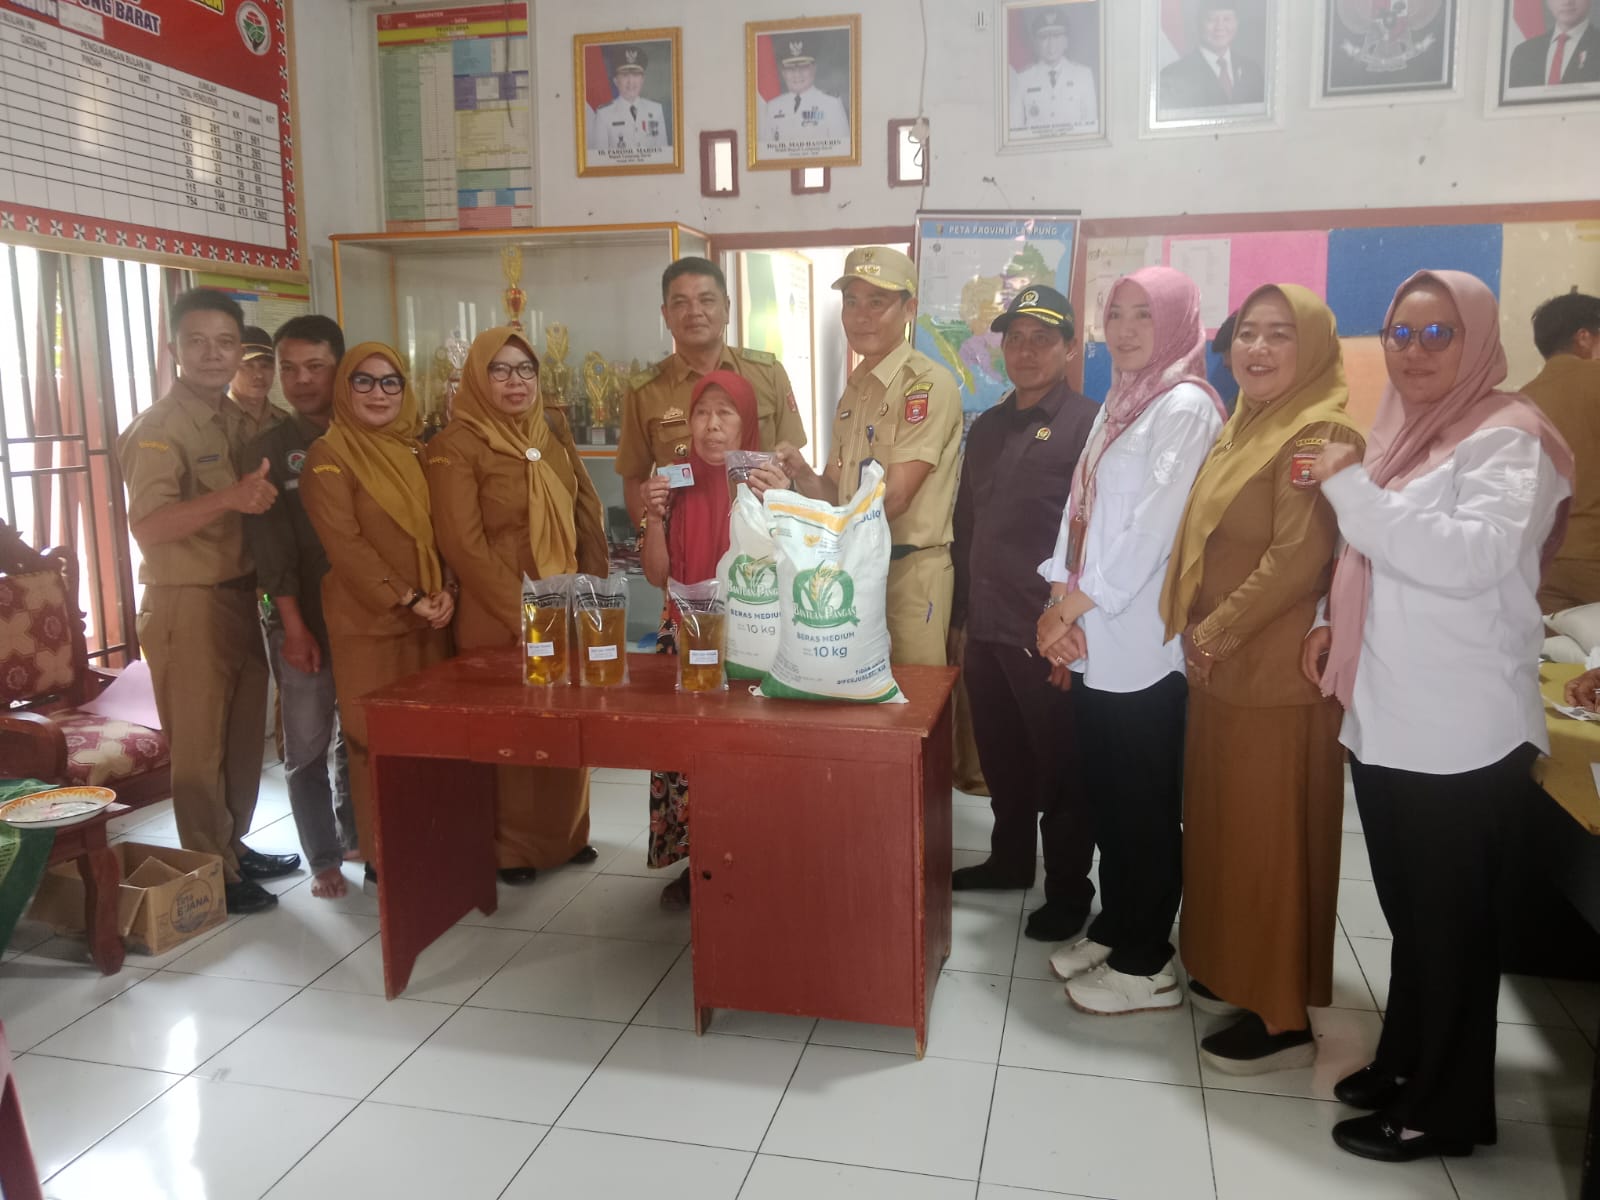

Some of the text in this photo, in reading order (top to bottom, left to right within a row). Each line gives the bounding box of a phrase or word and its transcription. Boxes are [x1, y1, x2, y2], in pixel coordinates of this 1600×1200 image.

[115, 1, 160, 33] BARAT
[949, 226, 970, 235] PETA
[972, 226, 1013, 235] PROVINSI
[731, 609, 783, 620] BERAS MEDIU
[747, 624, 758, 634] 10
[761, 624, 776, 636] kg
[797, 631, 855, 642] BERAS MEDIUM
[813, 646, 829, 658] 10
[832, 645, 848, 658] kg
